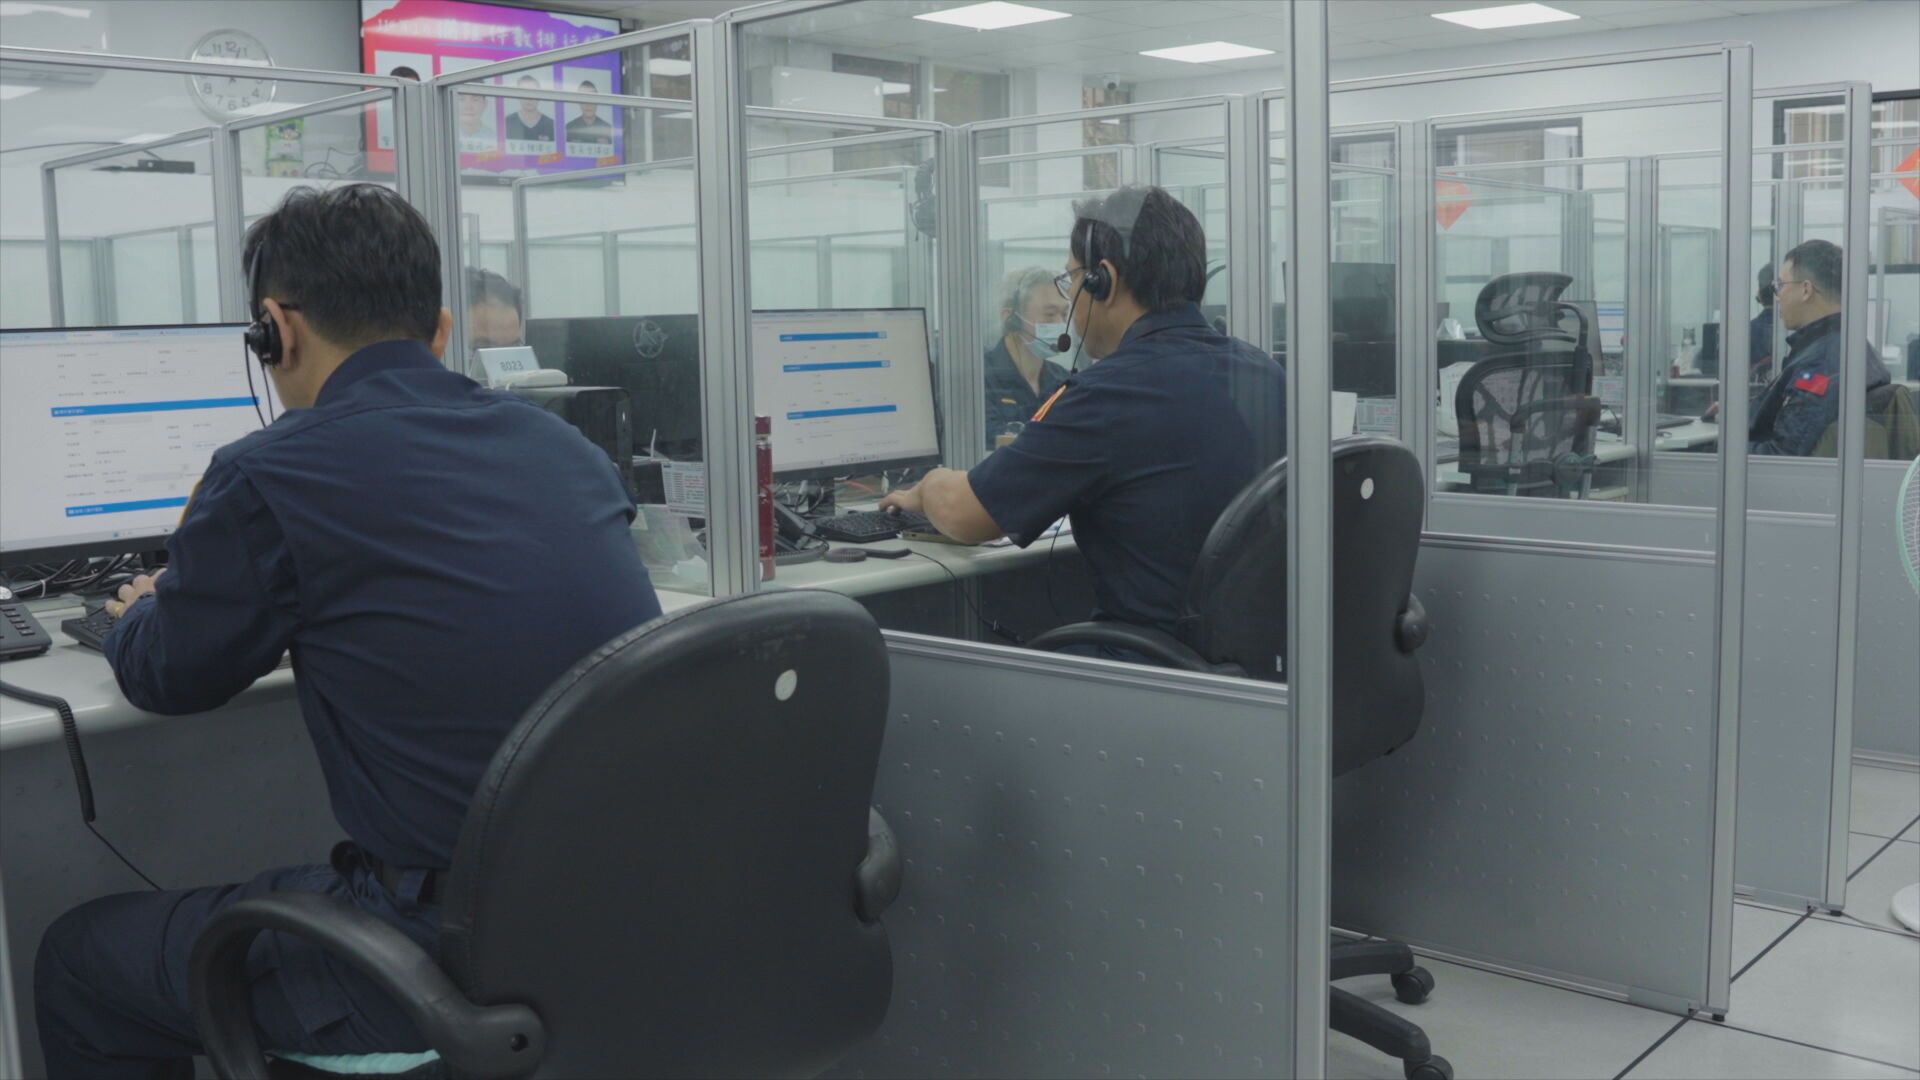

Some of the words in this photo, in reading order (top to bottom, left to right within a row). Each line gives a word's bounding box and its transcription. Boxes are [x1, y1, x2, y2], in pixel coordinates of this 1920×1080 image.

[212, 43, 222, 54] 11
[225, 41, 237, 53] 12
[203, 82, 212, 95] 8
[251, 87, 259, 98] 4
[228, 101, 237, 111] 6
[241, 96, 250, 108] 5
[500, 360, 524, 371] 8023
